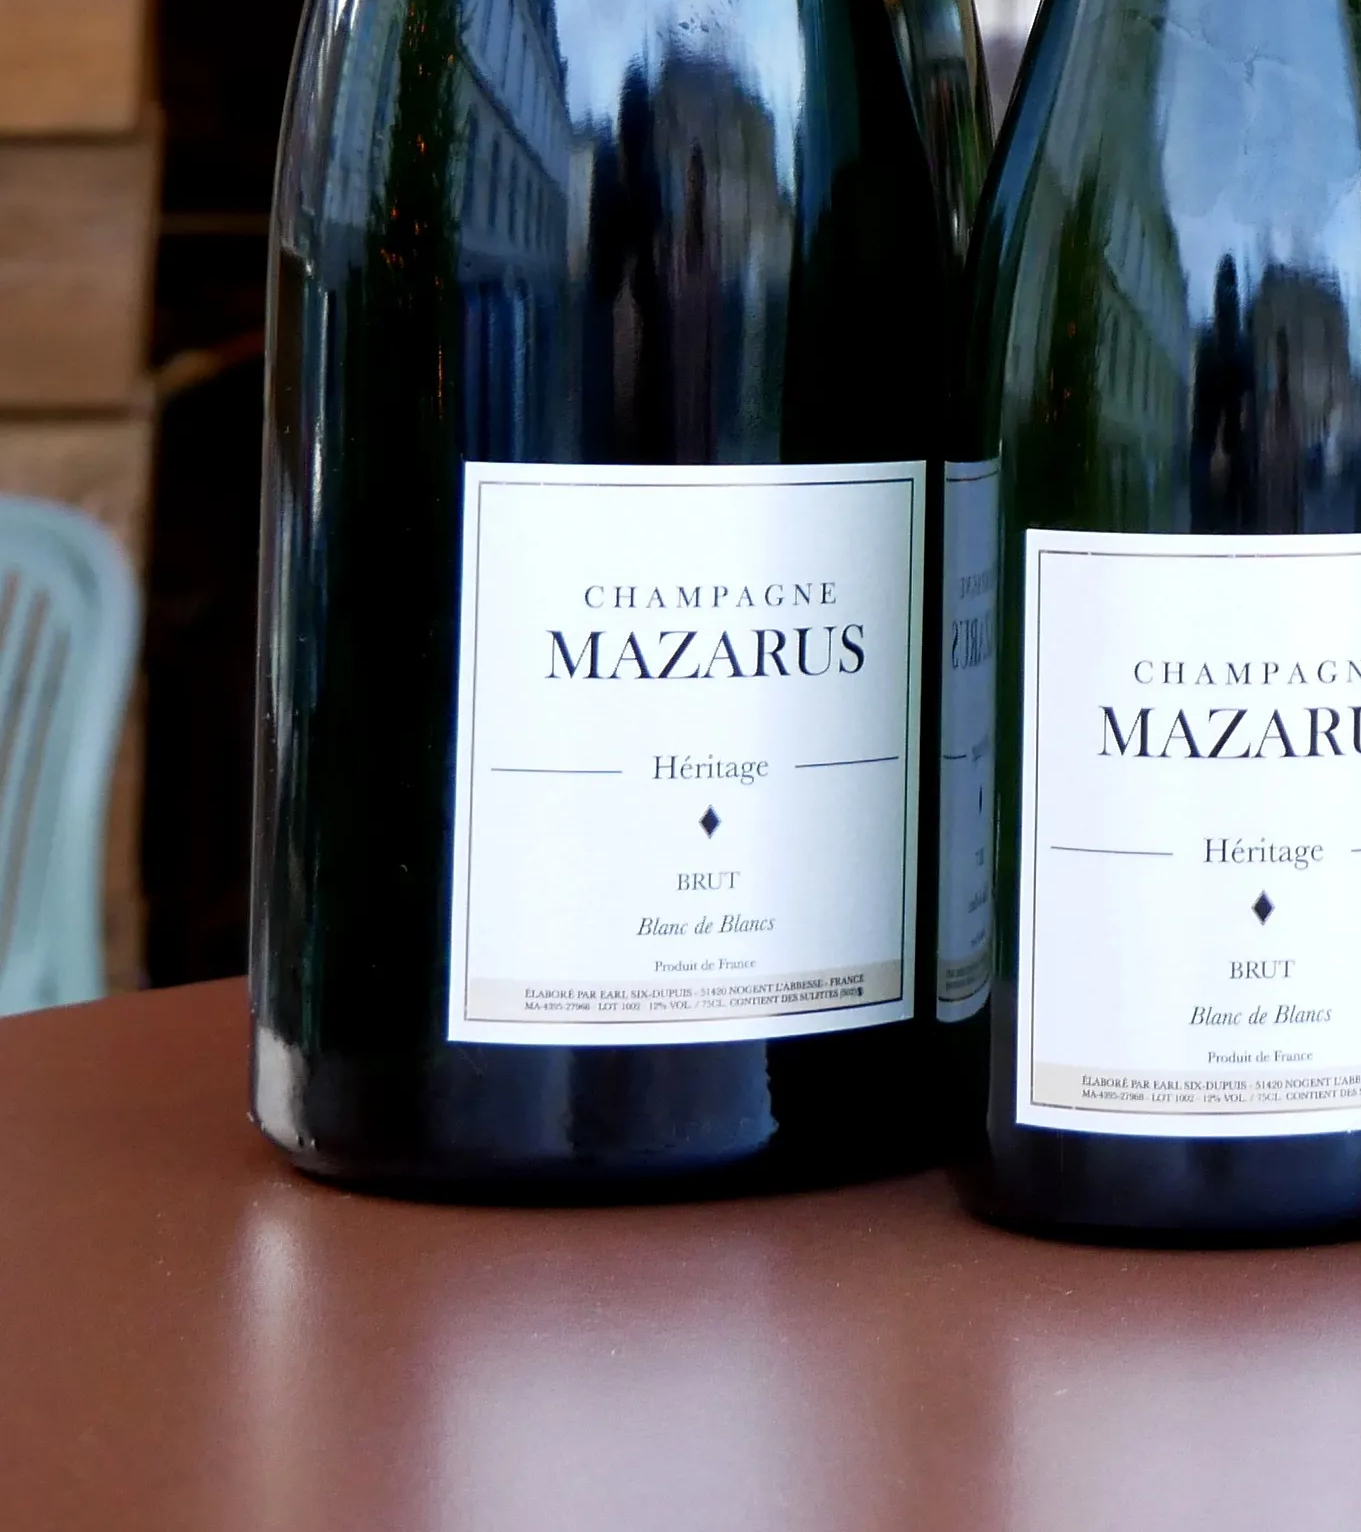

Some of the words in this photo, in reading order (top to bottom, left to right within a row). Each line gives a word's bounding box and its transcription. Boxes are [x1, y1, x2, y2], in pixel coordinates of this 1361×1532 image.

[584, 580, 838, 610] CHAMPAGNE
[545, 622, 866, 681] MAZARUS
[653, 754, 769, 785] Héritage
[1203, 837, 1324, 871] Héritage
[676, 871, 741, 891] BRUT
[636, 916, 688, 936] Blanc
[694, 915, 713, 935] de
[719, 913, 776, 934] Blancs
[655, 960, 698, 972] Produit
[701, 959, 715, 971] de
[718, 957, 756, 970] France
[1229, 959, 1295, 979] BRUT
[525, 988, 574, 999] ÉLABORÉ
[577, 989, 596, 999] PAR
[600, 990, 628, 999] EARL
[631, 989, 693, 999] SIX-DUPUIS
[701, 987, 727, 996] 51420
[729, 983, 773, 995] NOGENT
[830, 973, 864, 986] FRANCE
[598, 1002, 617, 1011] LOT
[649, 1001, 667, 1011] 12%
[729, 994, 778, 1007] CONTIENT
[781, 992, 798, 1004] DES
[1189, 1006, 1242, 1026] Blanc
[1248, 1005, 1268, 1025] de
[1273, 1004, 1332, 1024] Blancs
[1208, 1051, 1252, 1064] Produit
[1255, 1050, 1270, 1063] de
[1274, 1050, 1313, 1062] France
[1082, 1075, 1128, 1087] ÉLABORÉ
[1131, 1079, 1150, 1089] PAR
[1154, 1081, 1181, 1090] EARL
[1184, 1081, 1247, 1090] SIX-DUPUIS
[1255, 1080, 1282, 1090] 51420
[1285, 1077, 1331, 1089] NOGENT
[1152, 1094, 1171, 1103] LOT
[1175, 1094, 1194, 1103] 1002
[1203, 1094, 1221, 1103] 12%
[1286, 1088, 1337, 1101] CONTIENT
[1340, 1086, 1357, 1098] DES
